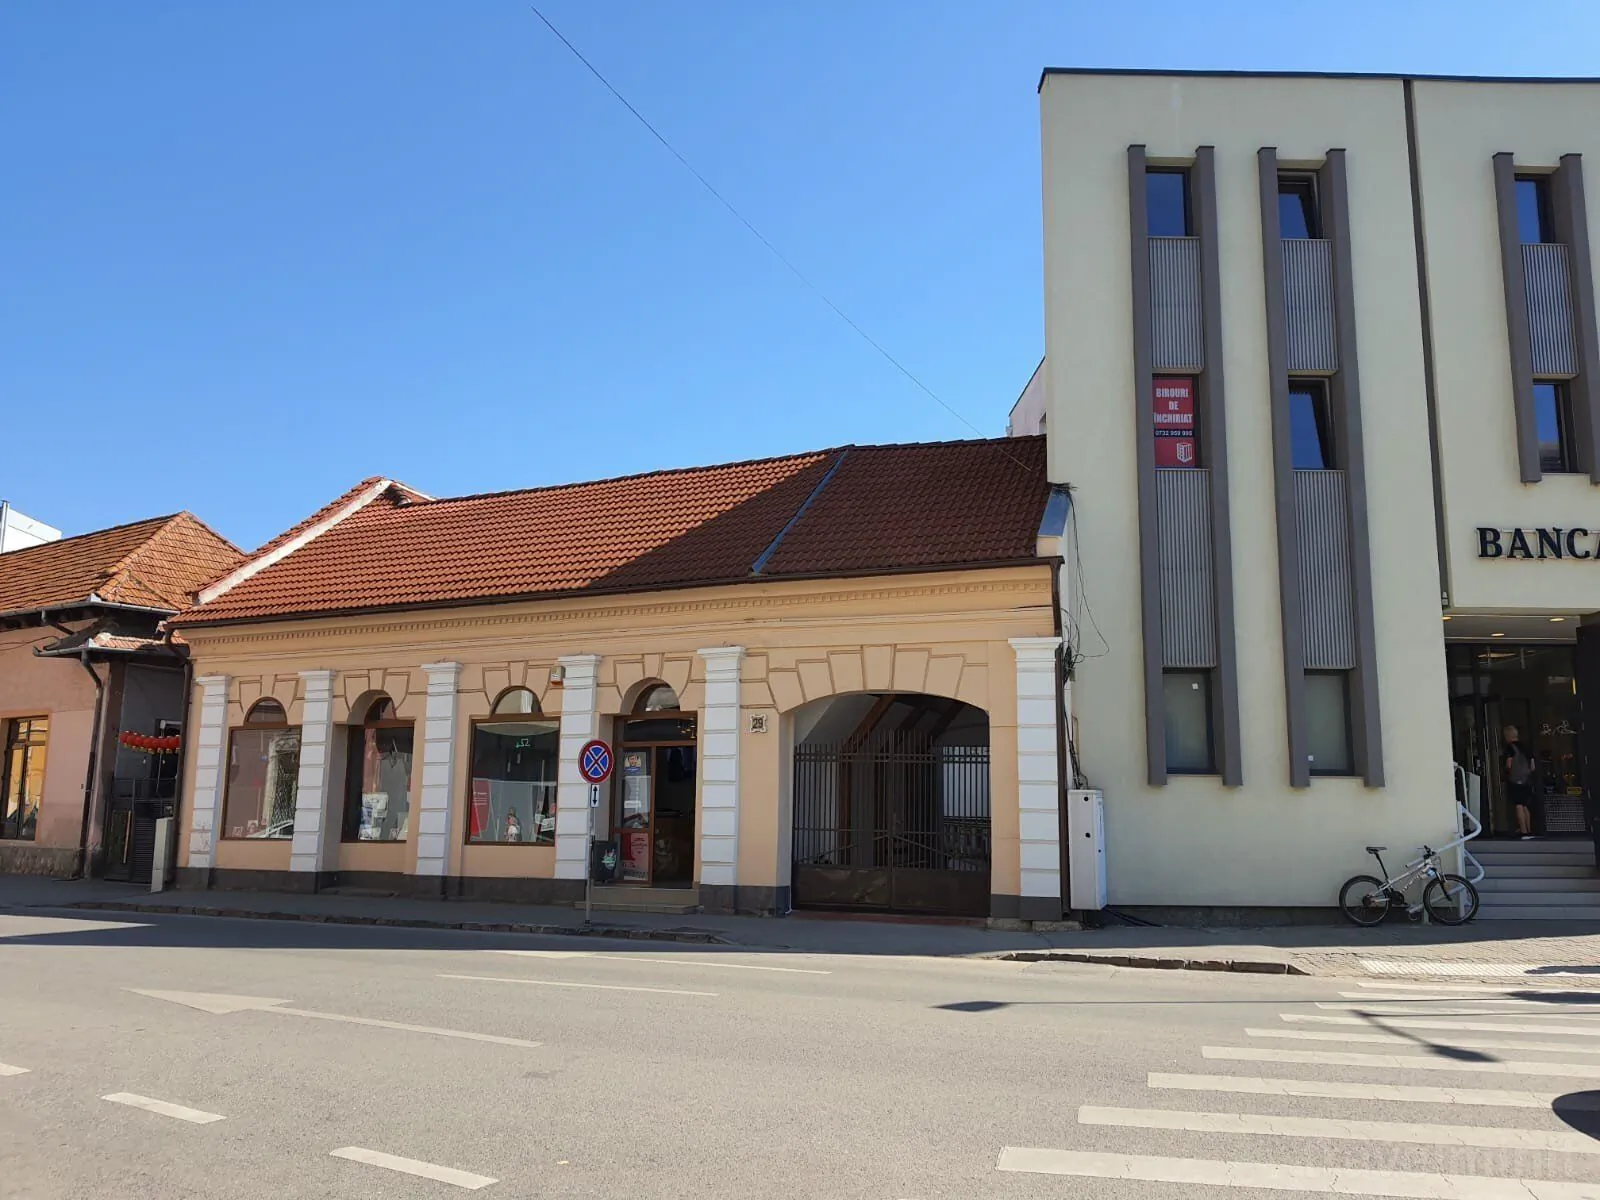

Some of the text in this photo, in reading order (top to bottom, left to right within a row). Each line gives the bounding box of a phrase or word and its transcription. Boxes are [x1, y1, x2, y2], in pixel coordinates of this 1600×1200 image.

[1156, 388, 1188, 397] BIROURI
[1169, 401, 1179, 410] DE
[1477, 527, 1600, 559] BANC
[752, 717, 764, 729] 29
